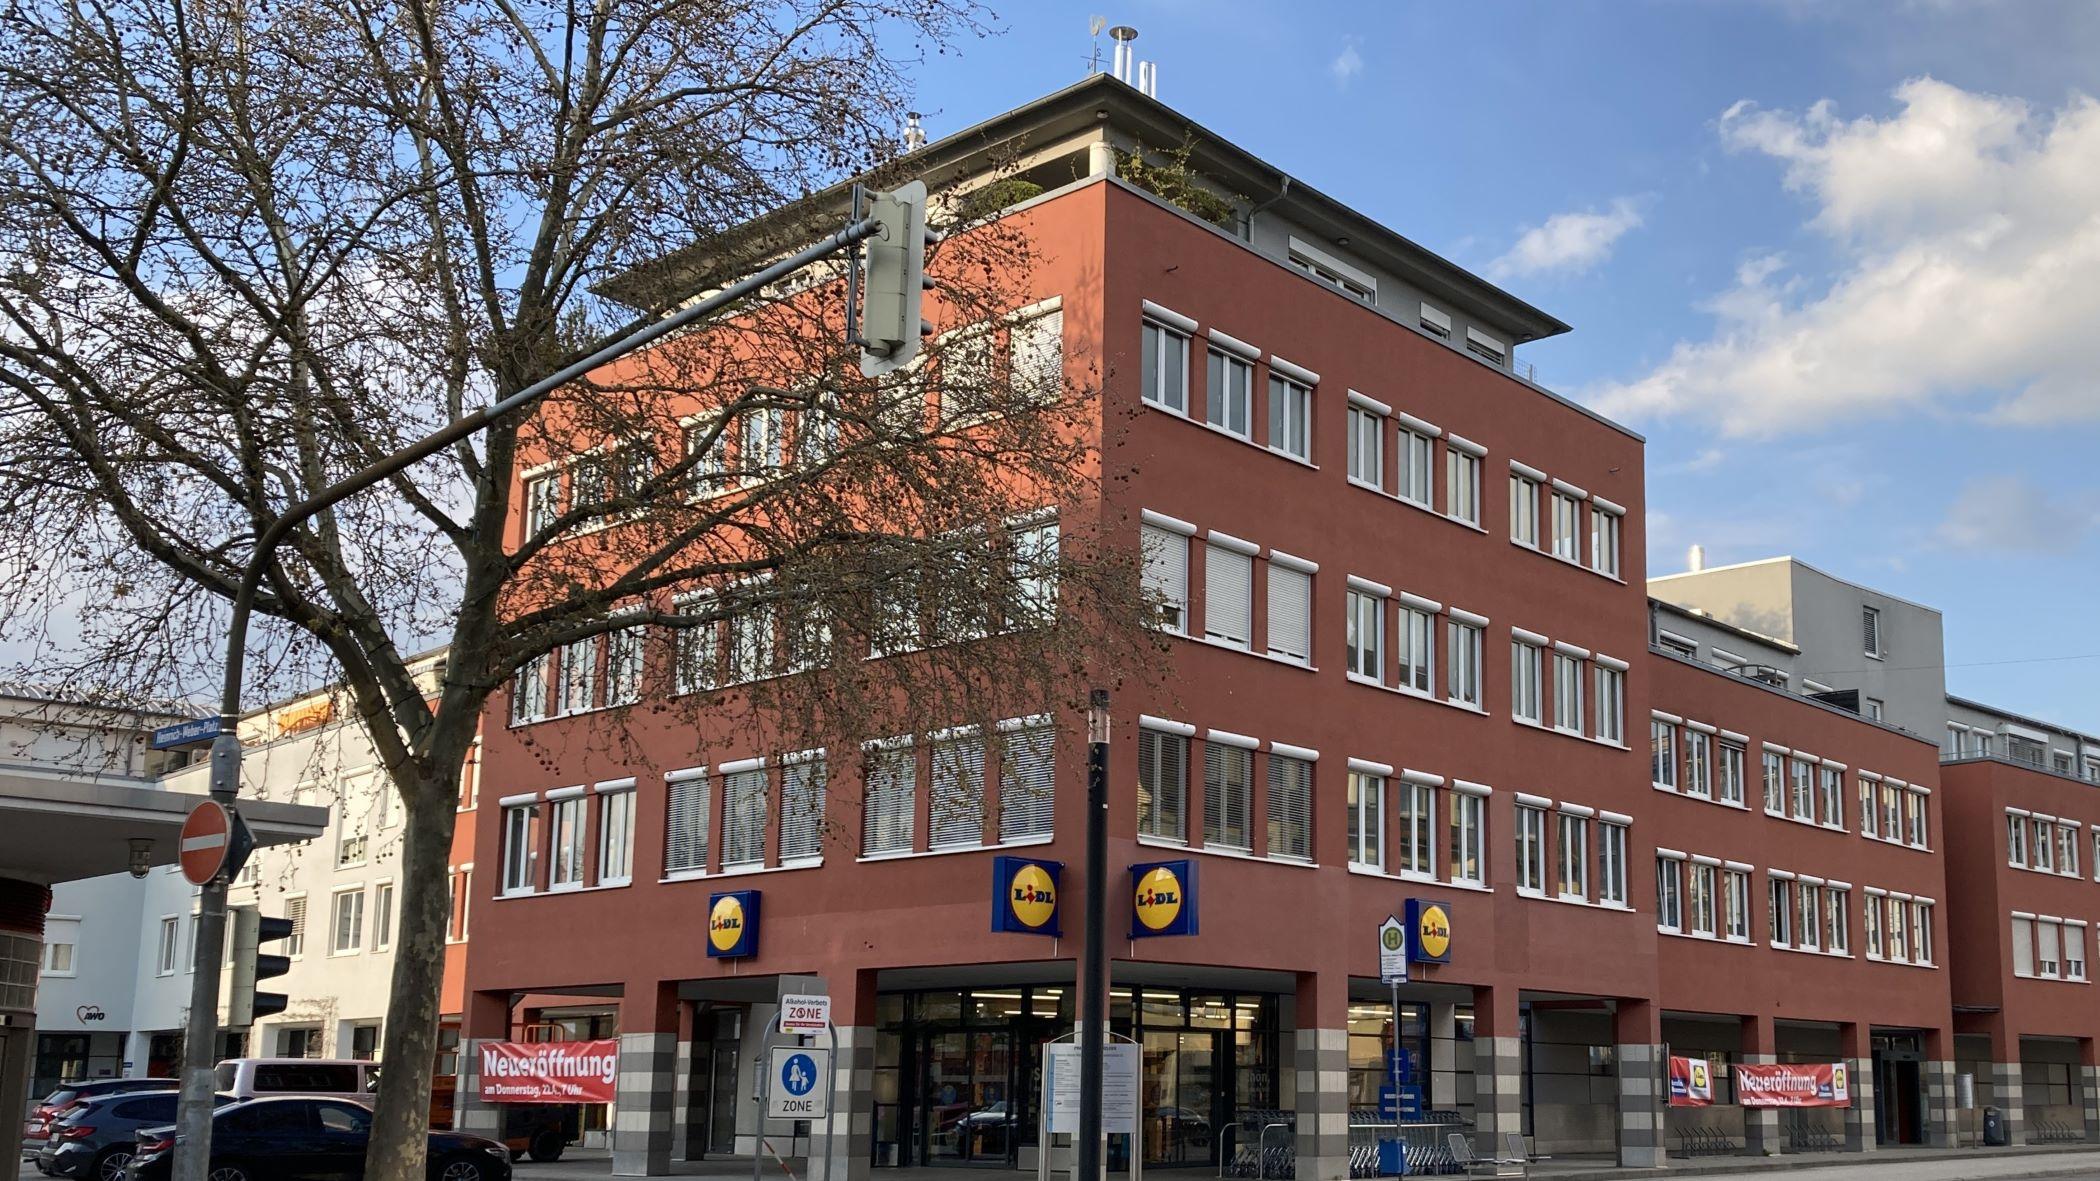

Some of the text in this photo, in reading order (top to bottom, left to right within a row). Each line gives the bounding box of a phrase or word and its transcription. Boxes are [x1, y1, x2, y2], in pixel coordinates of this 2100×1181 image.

[1387, 932, 1398, 945] H
[84, 1012, 105, 1021] AWO
[789, 1007, 821, 1019] ZONE
[484, 1048, 616, 1084] Neueröffnung
[1739, 1070, 1817, 1096] Neueröffnung
[485, 1086, 495, 1095] am
[496, 1084, 540, 1098] Donnerstag,
[567, 1084, 583, 1096] Uhr
[783, 1100, 813, 1112] ZONE
